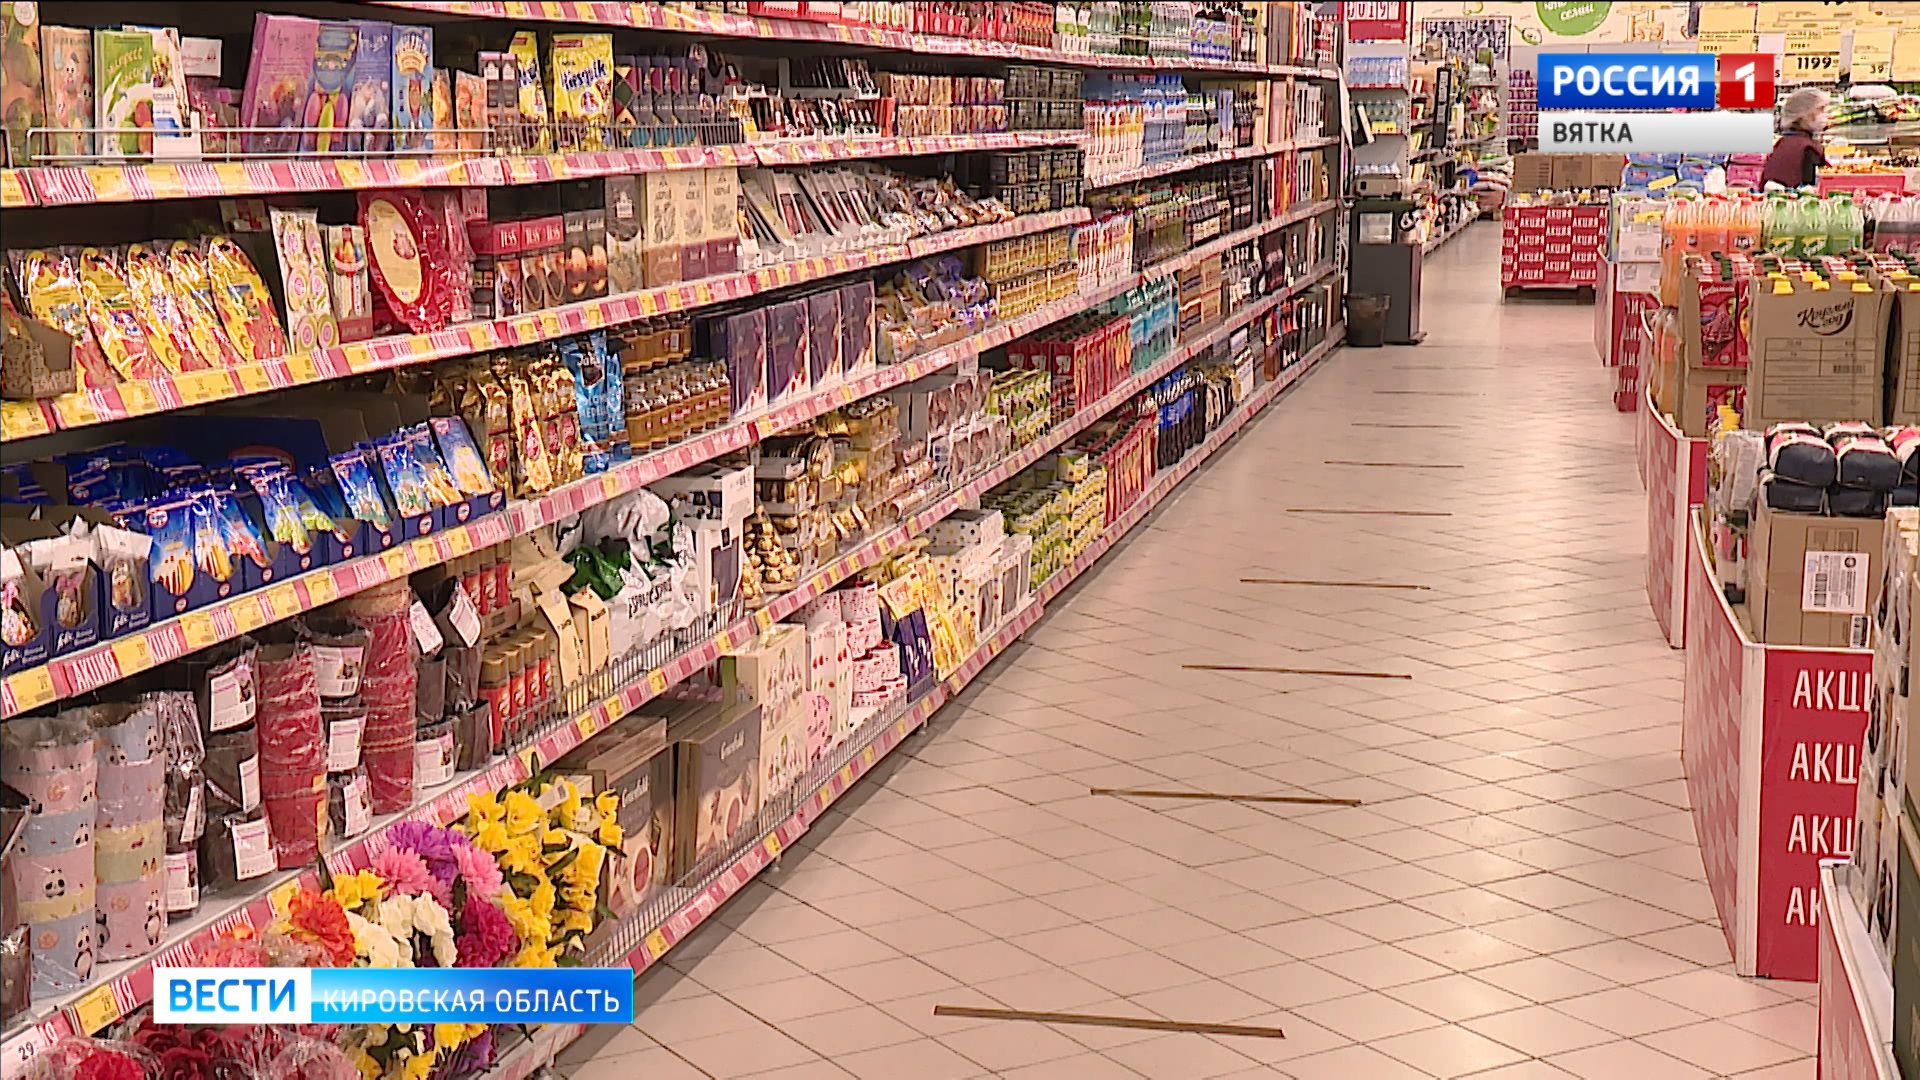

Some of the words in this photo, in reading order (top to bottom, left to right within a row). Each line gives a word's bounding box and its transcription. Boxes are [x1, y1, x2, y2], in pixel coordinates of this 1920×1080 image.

[1797, 56, 1832, 70] 1199
[1546, 209, 1572, 220] АКЦИЯ
[1520, 217, 1546, 228] АКЦИЯ
[1572, 217, 1599, 228] АКЦИЯ
[1546, 225, 1572, 237] АКЦИЯ
[1519, 234, 1545, 246] АКЦИЯ
[1571, 234, 1598, 246] АКЦИЯ
[1545, 243, 1571, 254] АКЦИЯ
[1519, 251, 1545, 262] АКЦИЯ
[1570, 251, 1597, 262] АКЦИЯ
[1544, 261, 1570, 272] АКЦИЯ
[1518, 269, 1544, 280] АКЦИЯ
[1570, 269, 1597, 280] АКЦИЯ
[72, 649, 119, 691] АКЦИЯ
[18, 1041, 35, 1061] 29
